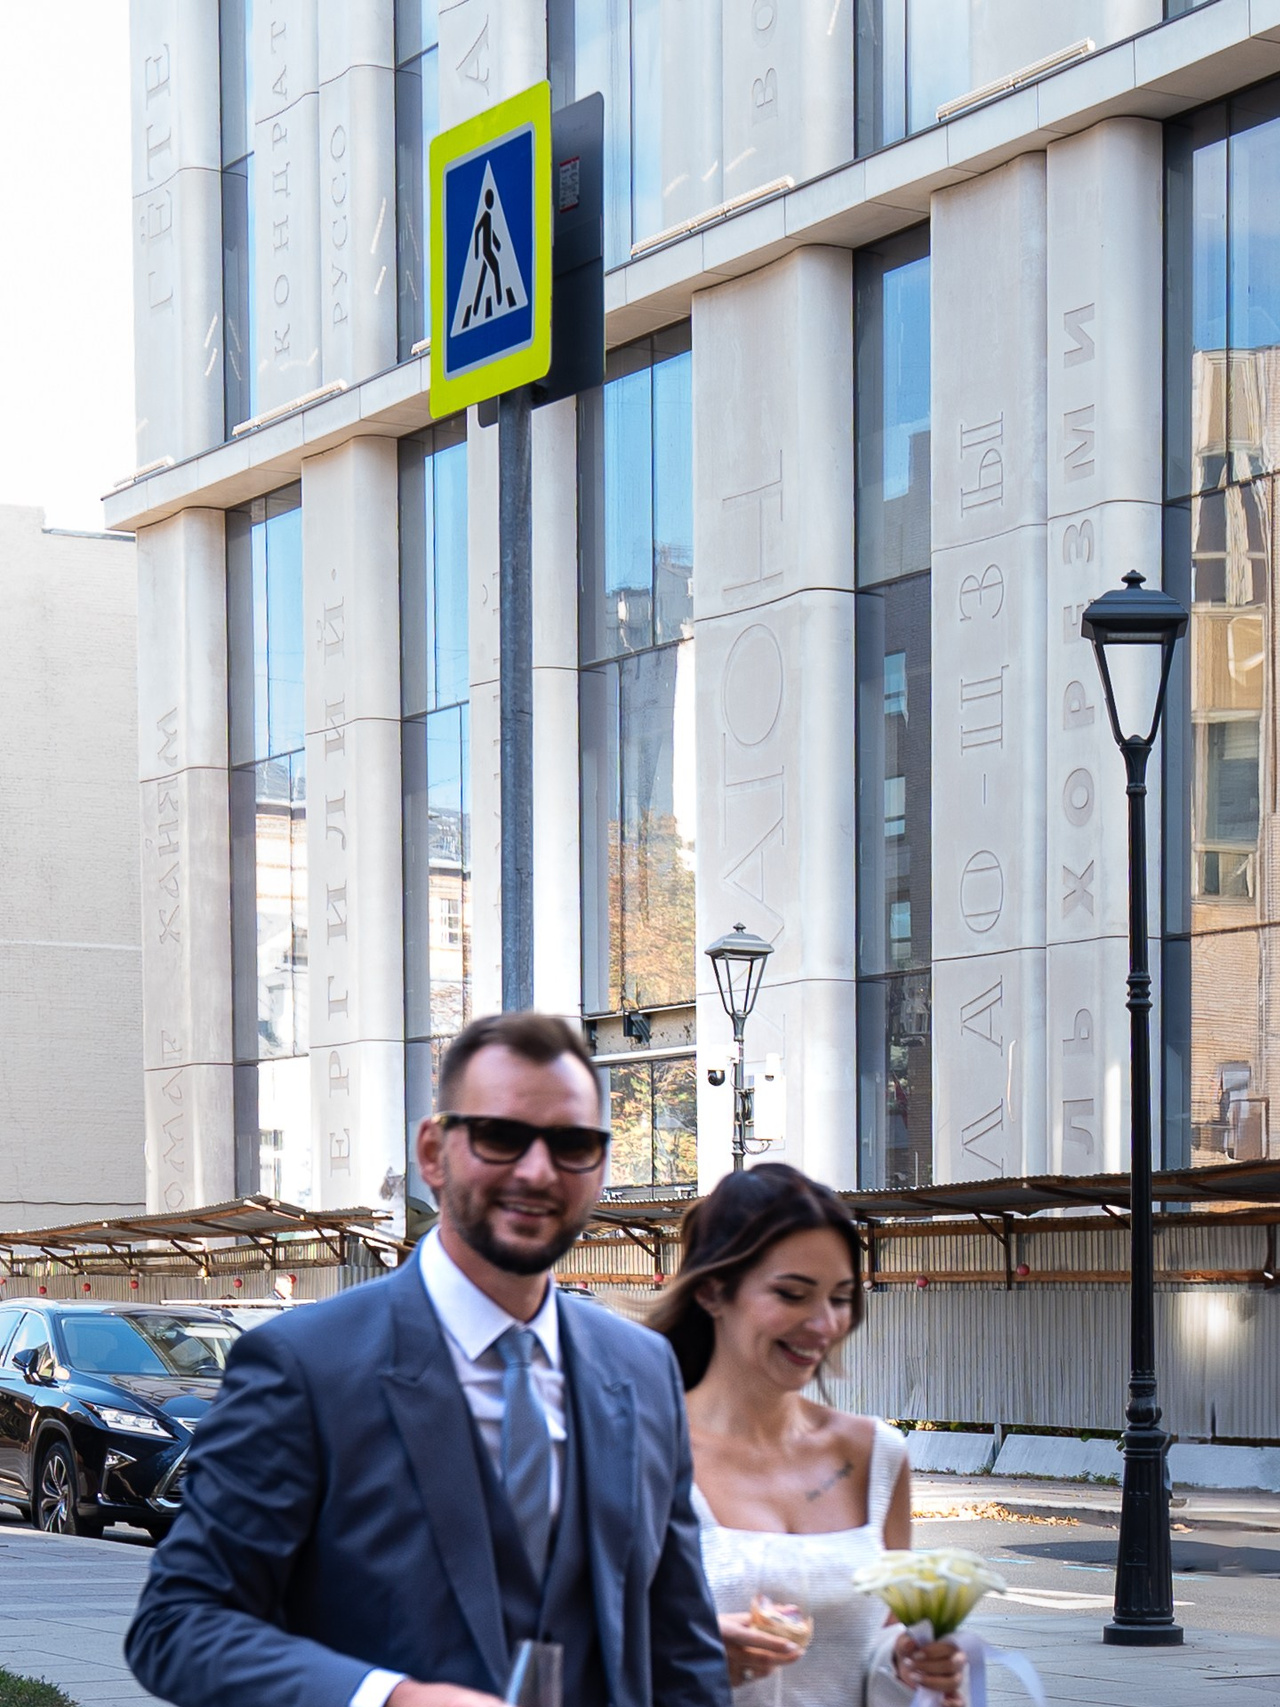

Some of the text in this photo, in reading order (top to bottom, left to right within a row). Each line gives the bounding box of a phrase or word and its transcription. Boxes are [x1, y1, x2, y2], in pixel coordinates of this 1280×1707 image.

[138, 41, 175, 315] ГЁТЕ
[269, 0, 292, 360] КОНДРАТ
[329, 124, 349, 329] РУССО
[145, 706, 186, 1211] ОМАР ХАЙЯМ
[1061, 1007, 1095, 1155] ЛЬ
